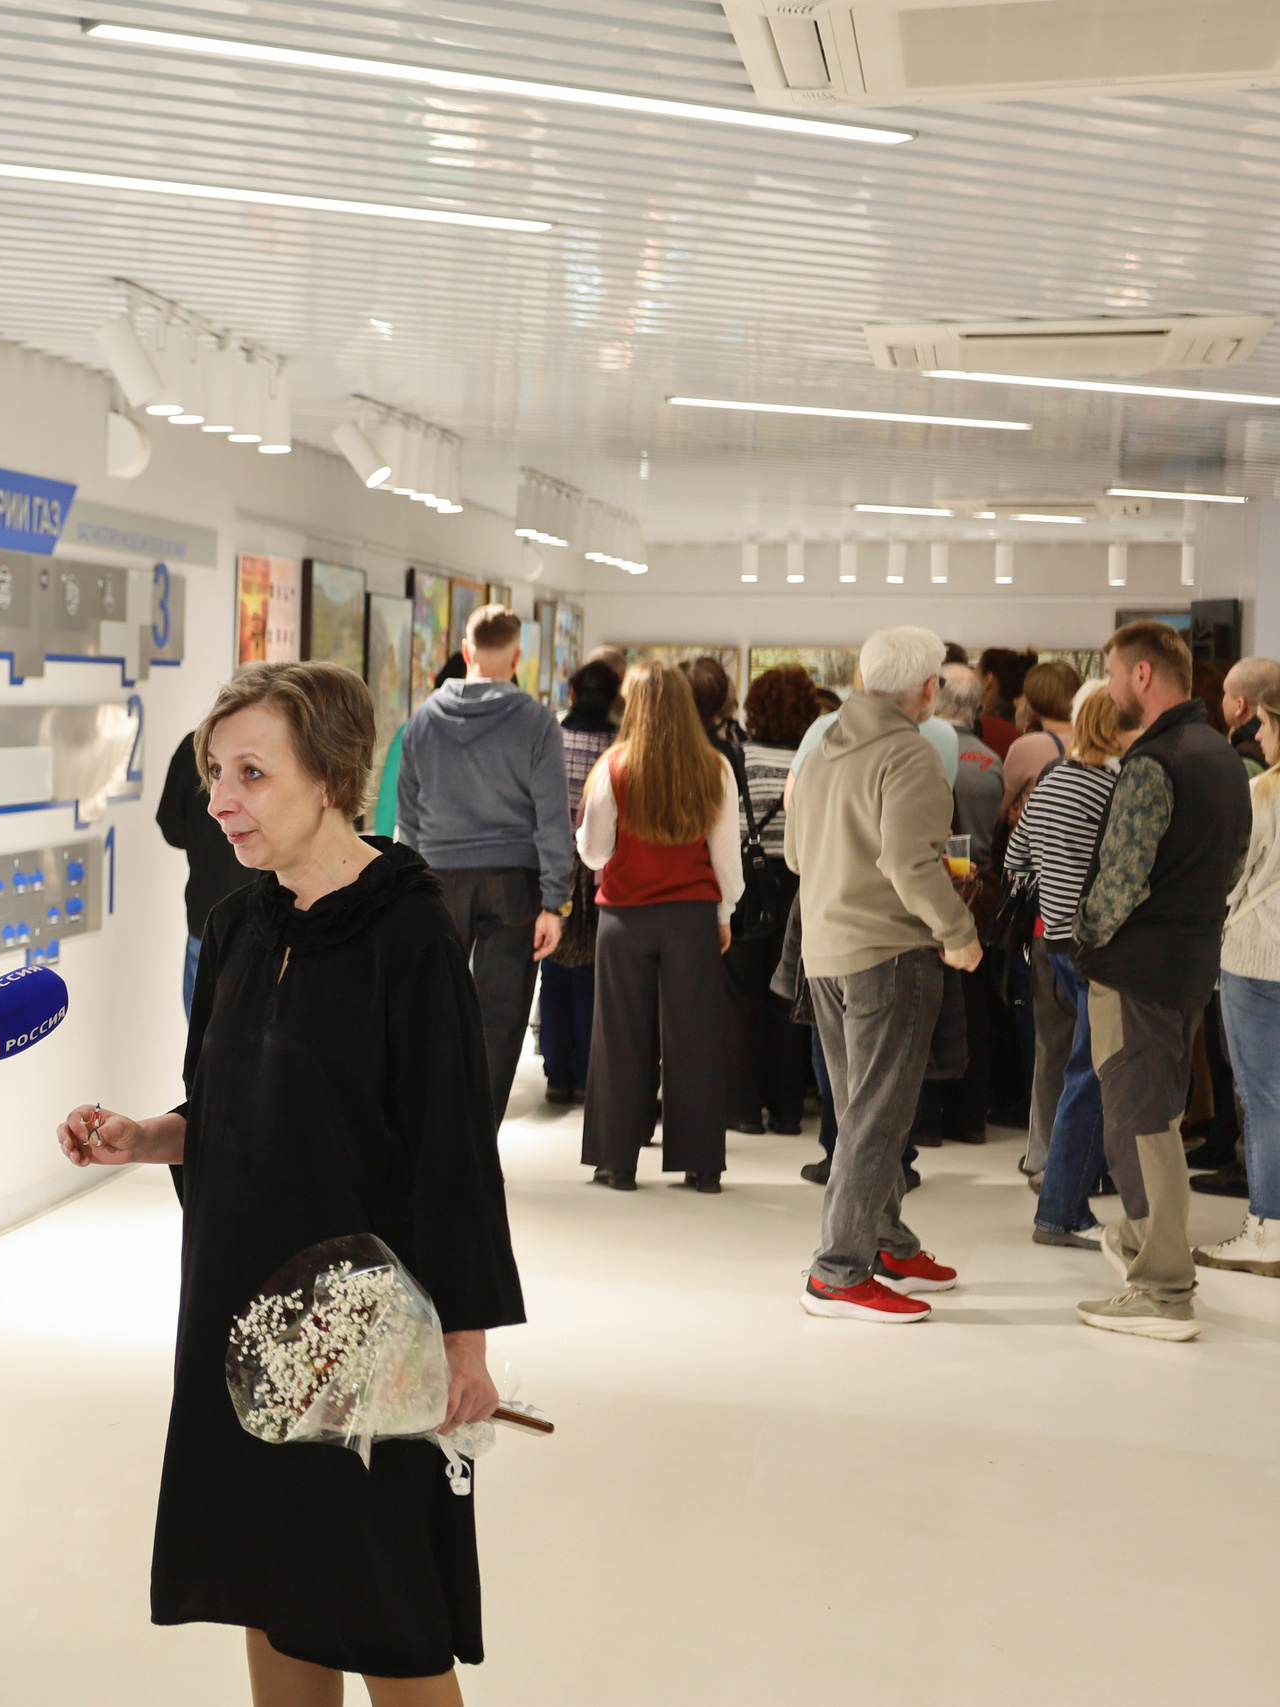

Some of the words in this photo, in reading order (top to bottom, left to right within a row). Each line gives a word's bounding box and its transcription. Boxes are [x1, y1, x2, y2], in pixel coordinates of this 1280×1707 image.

[32, 495, 62, 538] ГАЗ
[152, 562, 170, 649] 3
[127, 694, 144, 782] 2
[104, 825, 115, 915] 1
[5, 1005, 66, 1052] РОССИЯ
